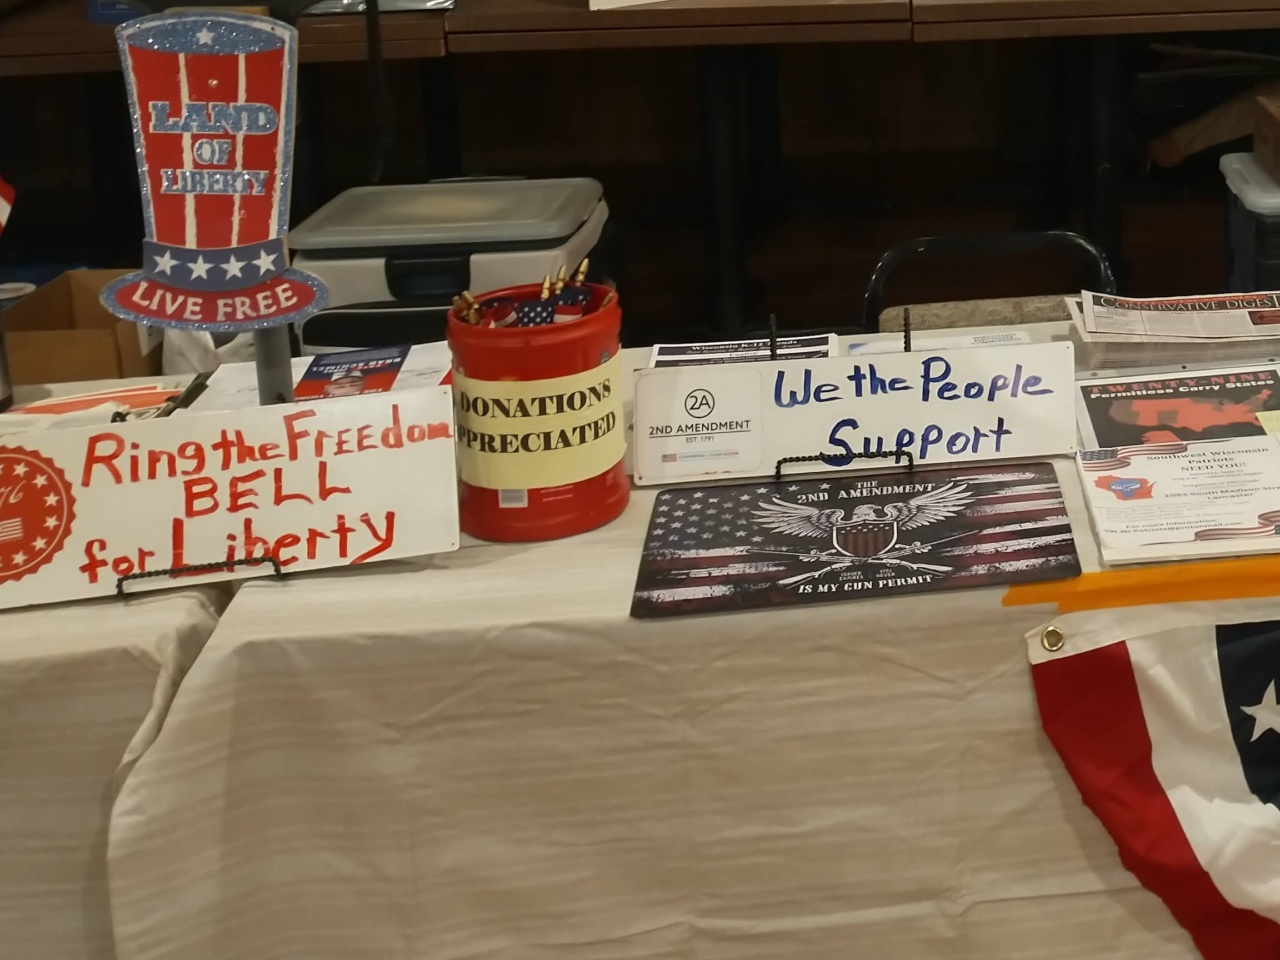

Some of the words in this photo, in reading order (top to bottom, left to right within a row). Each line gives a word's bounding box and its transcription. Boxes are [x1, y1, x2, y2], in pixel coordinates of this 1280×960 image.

[149, 101, 279, 134] LAND
[193, 138, 232, 165] OF
[160, 169, 269, 195] LIBERTY
[131, 280, 203, 320] LIVE
[216, 282, 298, 321] FREE
[1100, 297, 1219, 311] CONSERVATIVE
[1226, 293, 1280, 309] DIGEST
[774, 368, 844, 408] We
[846, 363, 914, 397] the
[920, 356, 1054, 402] People
[1088, 372, 1273, 394] TWENTY-NINE
[1090, 388, 1174, 399] Permitless
[1179, 384, 1220, 392] Carry
[1225, 379, 1275, 388] States
[460, 378, 611, 418] DONATIONS
[689, 395, 711, 410] 2A
[458, 411, 616, 453] PPRECIATED
[649, 426, 673, 436] 2ND
[676, 420, 751, 434] AMENDMENT
[820, 417, 1012, 467] Support
[81, 431, 207, 488] Ring
[211, 428, 287, 471] the
[1181, 464, 1214, 472] NEED
[183, 459, 352, 518] BELL
[797, 492, 829, 503] 2ND
[838, 483, 936, 499] AMENDMENT
[856, 481, 878, 489] THE
[79, 538, 156, 584] for
[170, 511, 396, 579] Liberty
[798, 585, 812, 594] IS
[817, 583, 839, 593] MY
[844, 581, 873, 591] GUN
[878, 575, 933, 588] PERMIT
